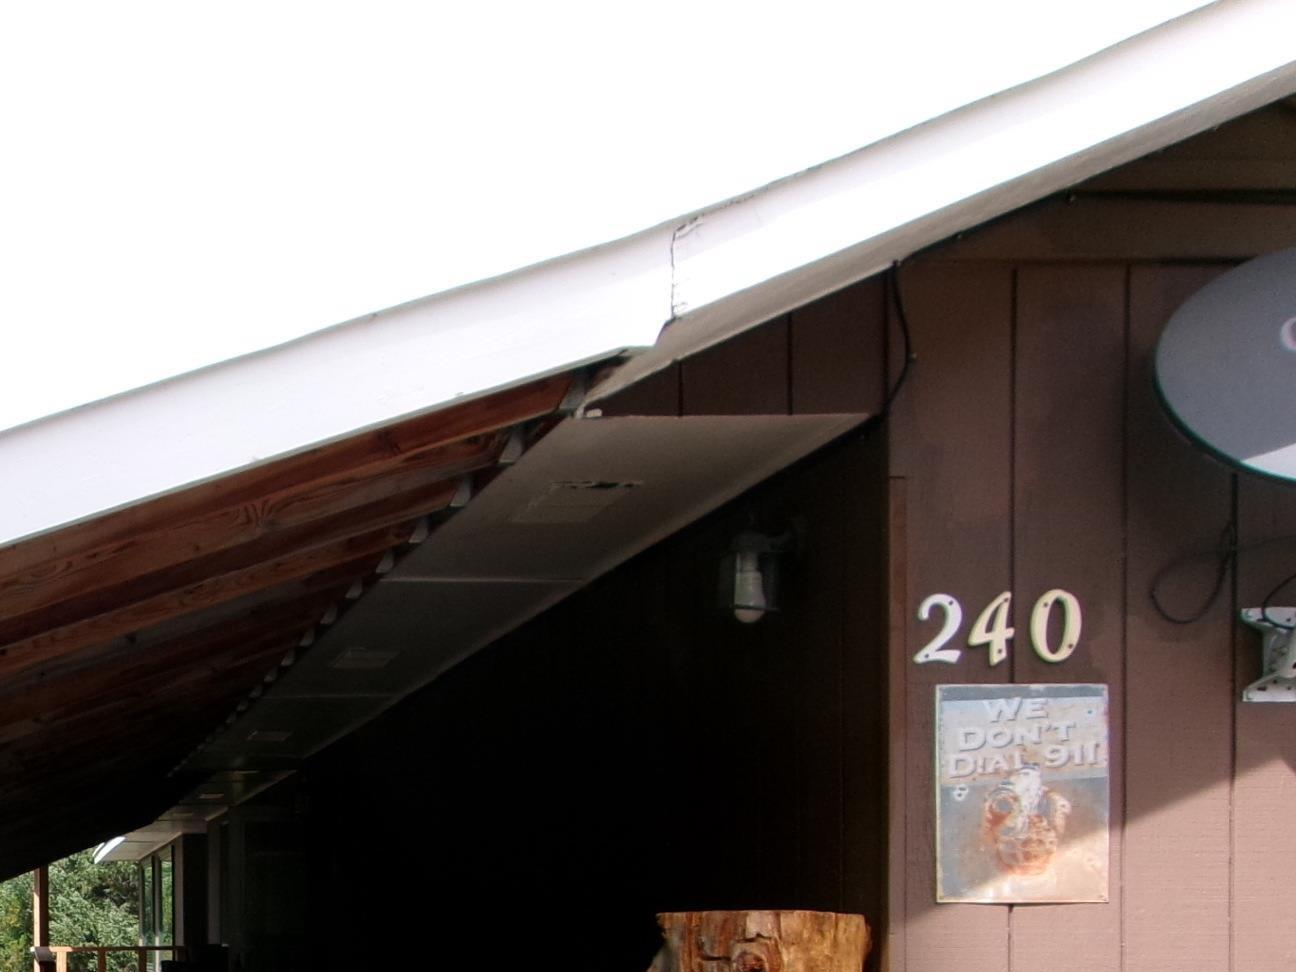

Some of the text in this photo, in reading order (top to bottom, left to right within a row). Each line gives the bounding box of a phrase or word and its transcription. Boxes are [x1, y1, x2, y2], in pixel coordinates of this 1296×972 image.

[913, 589, 1082, 666] 240
[983, 697, 1049, 723] WE
[958, 722, 1076, 752] DON'T
[948, 741, 1101, 779] DIAL 911
